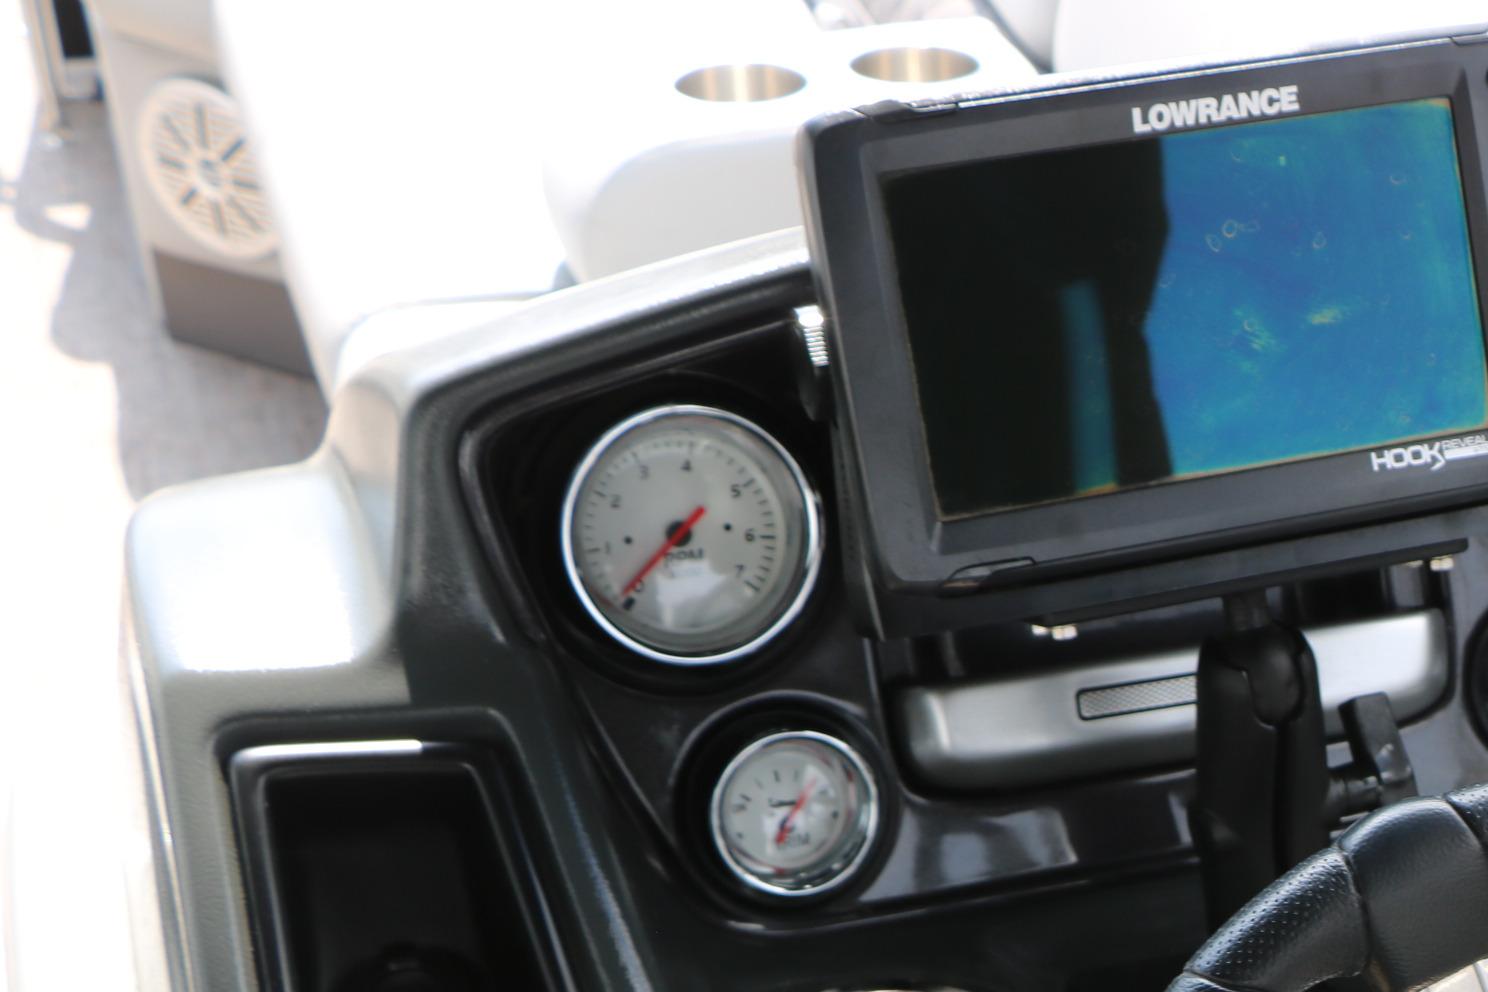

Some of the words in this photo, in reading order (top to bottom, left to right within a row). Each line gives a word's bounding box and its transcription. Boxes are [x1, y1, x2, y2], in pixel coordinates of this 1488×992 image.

[1131, 85, 1300, 133] LOWRANCE
[1370, 441, 1446, 472] HOOK
[680, 460, 693, 473] 4
[730, 484, 742, 499] 5
[744, 528, 756, 543] 6
[735, 564, 746, 577] 7
